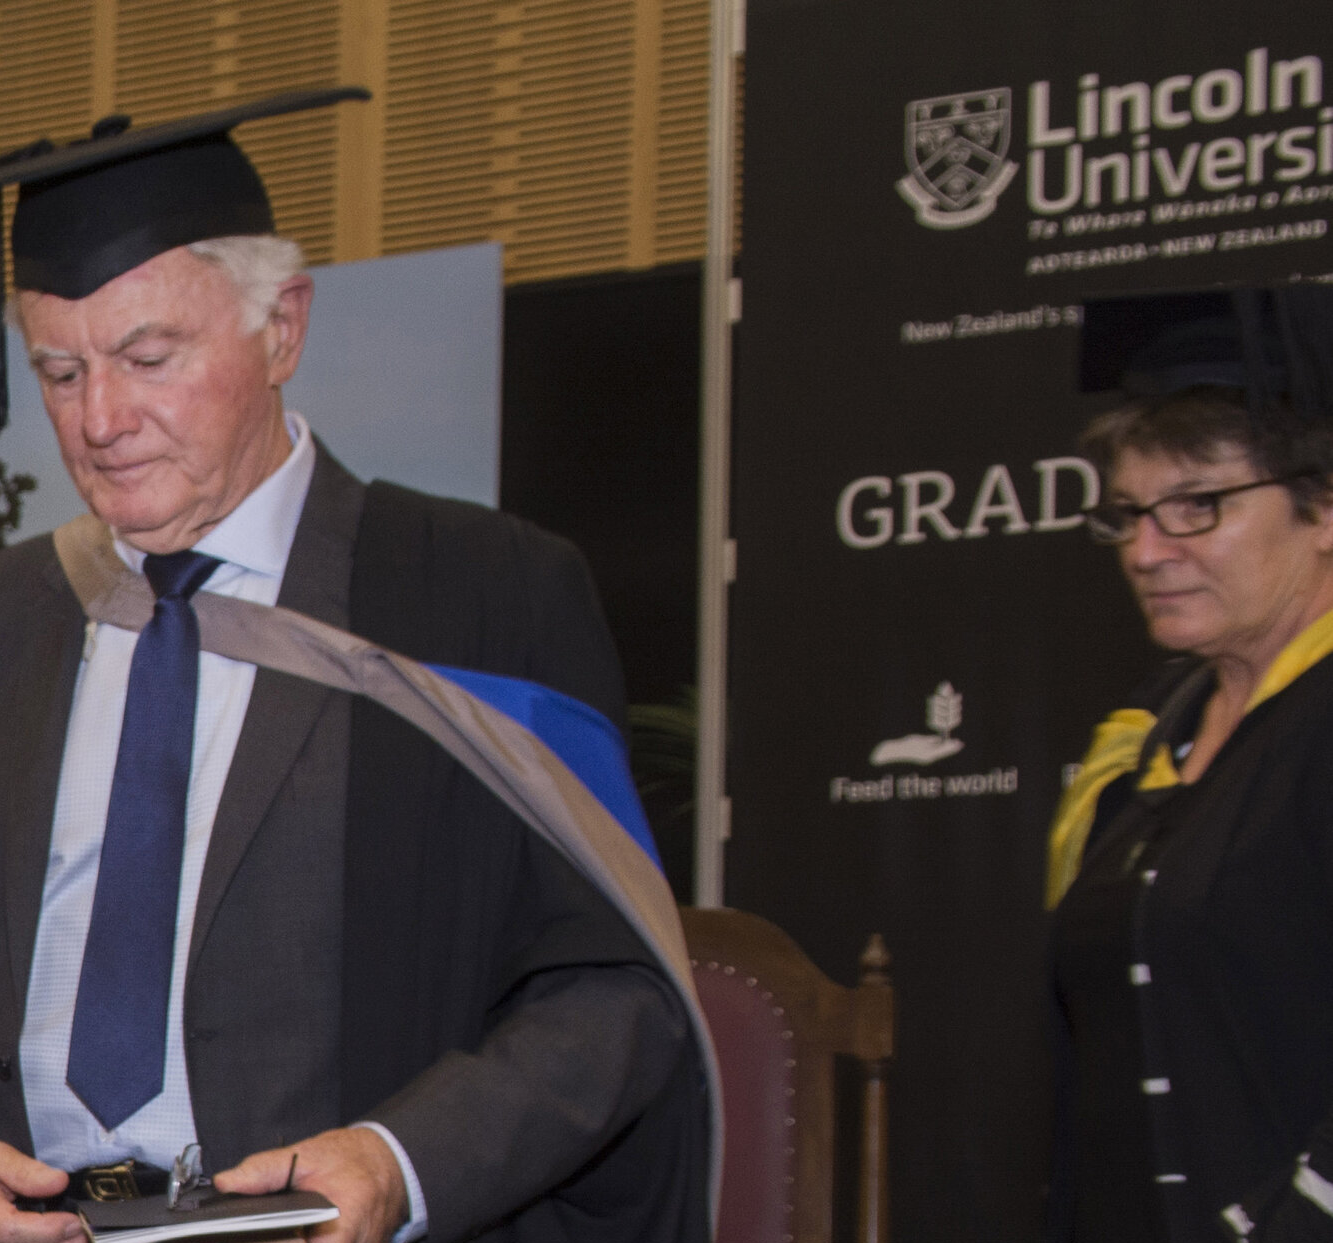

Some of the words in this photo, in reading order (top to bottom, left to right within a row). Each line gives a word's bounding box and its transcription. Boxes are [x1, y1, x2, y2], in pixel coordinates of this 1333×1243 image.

[1028, 47, 1323, 147] Lincoln
[901, 320, 954, 344] New
[954, 303, 1061, 339] Zealand's
[837, 456, 1100, 549] GRAD
[830, 775, 893, 802] Feed
[897, 772, 942, 799] the
[943, 766, 1017, 796] world
